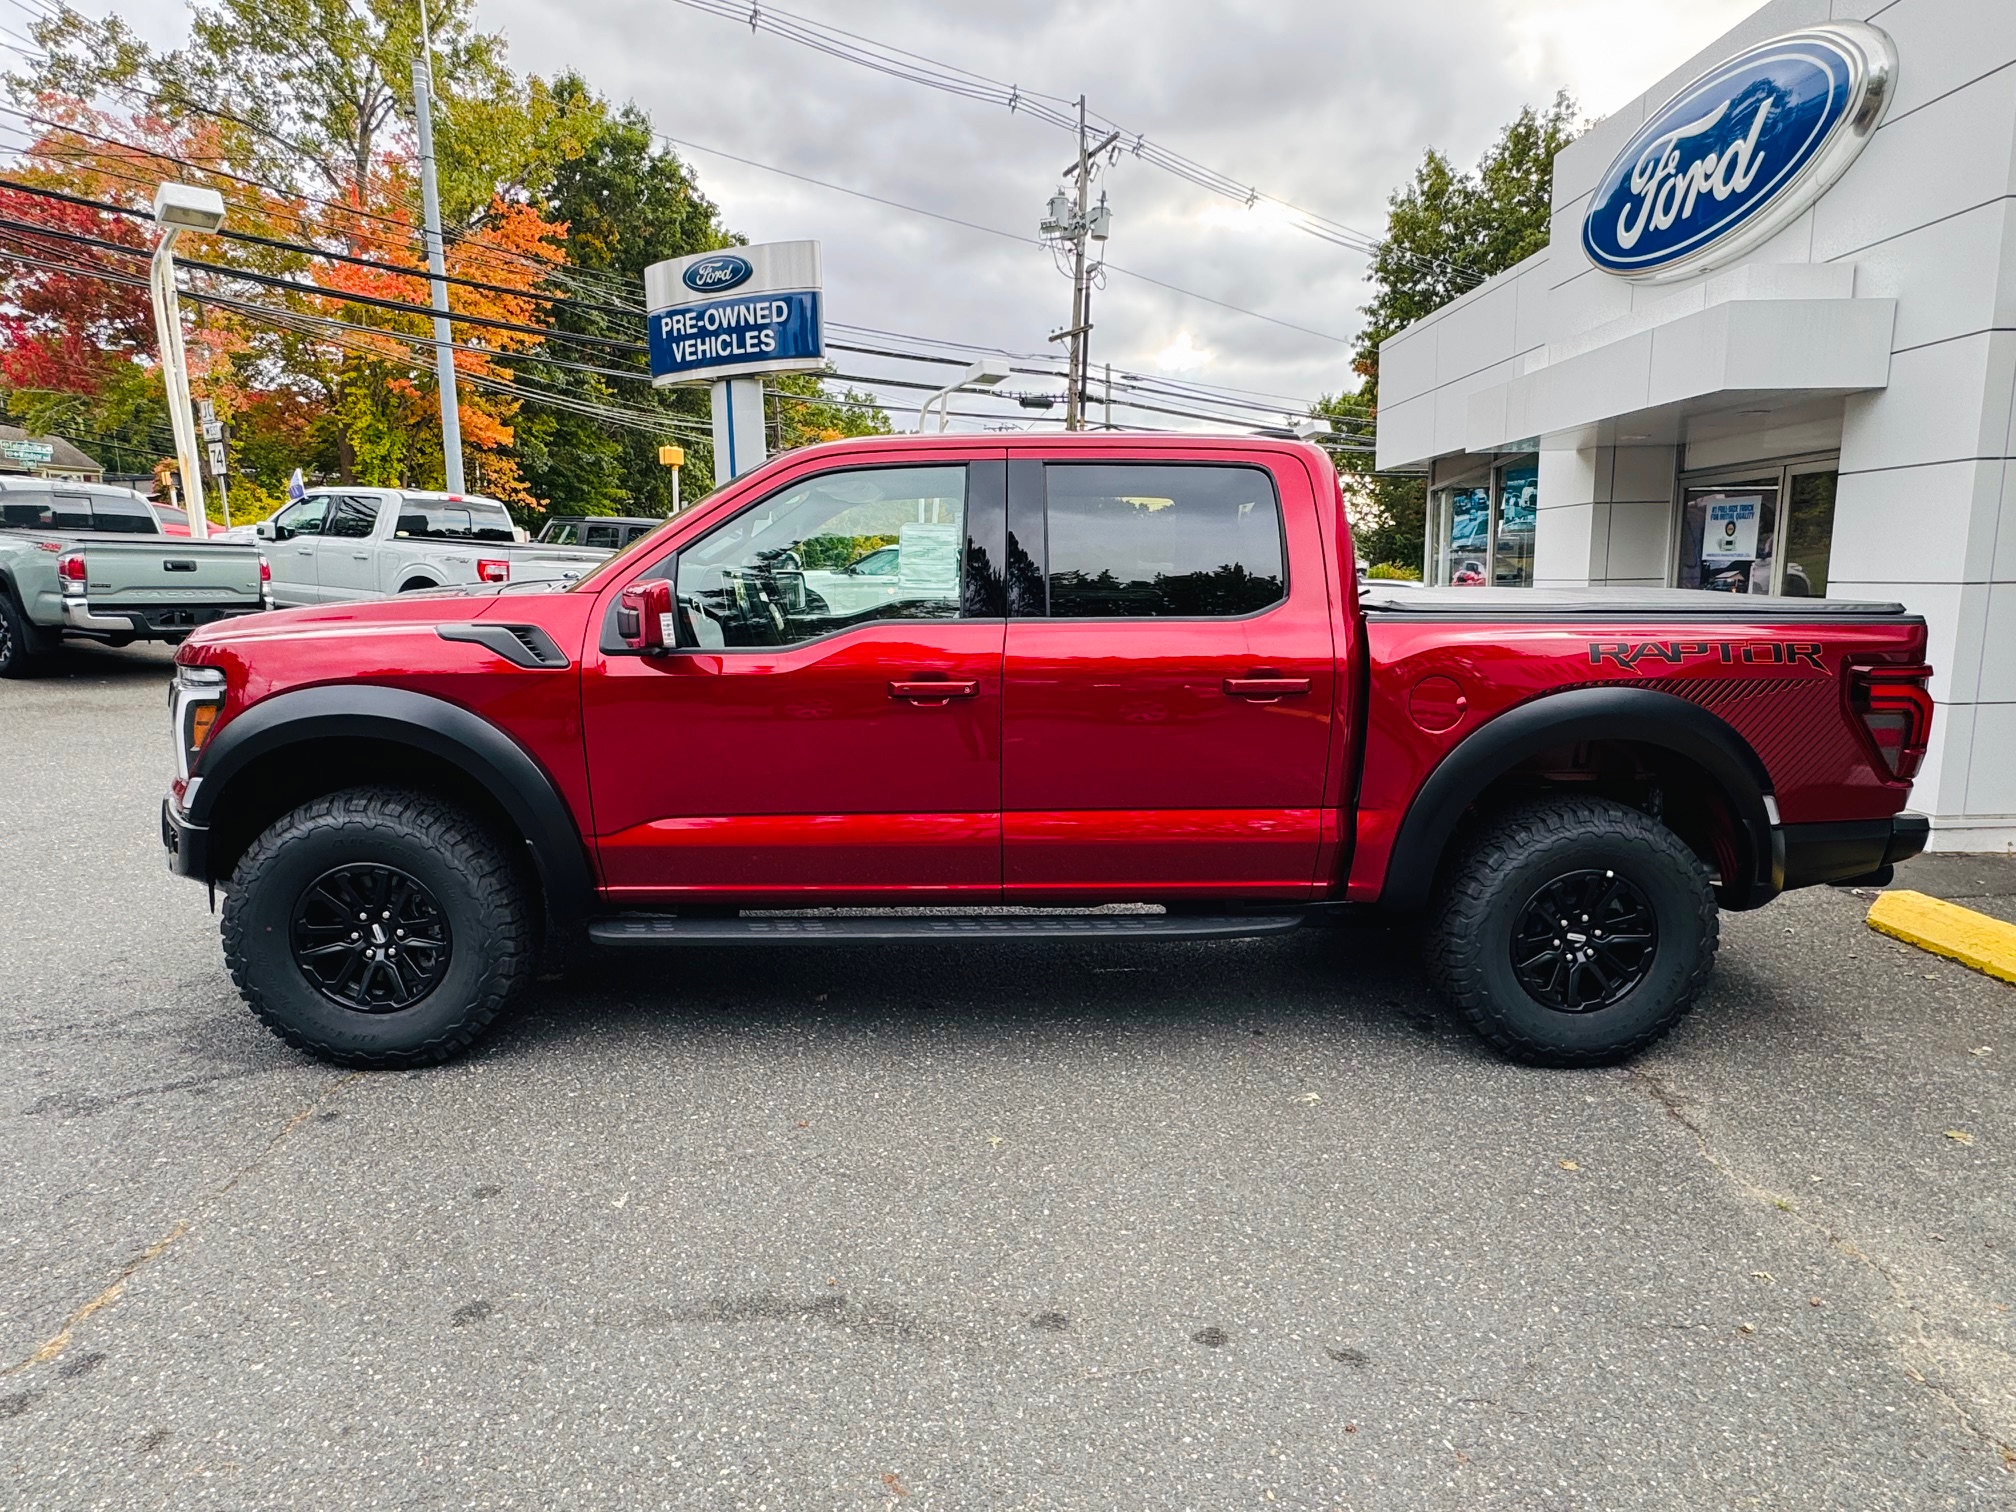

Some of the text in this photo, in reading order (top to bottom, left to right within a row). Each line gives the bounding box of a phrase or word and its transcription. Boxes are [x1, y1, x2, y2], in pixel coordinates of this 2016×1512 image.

[1617, 94, 1777, 250] Ford
[696, 261, 733, 286] Ford
[661, 301, 789, 339] PRE-OWNED
[672, 329, 777, 363] VEHICLES
[210, 449, 223, 467] 74
[1736, 512, 1755, 521] QUALITY
[1587, 641, 1833, 676] RAPTOR
